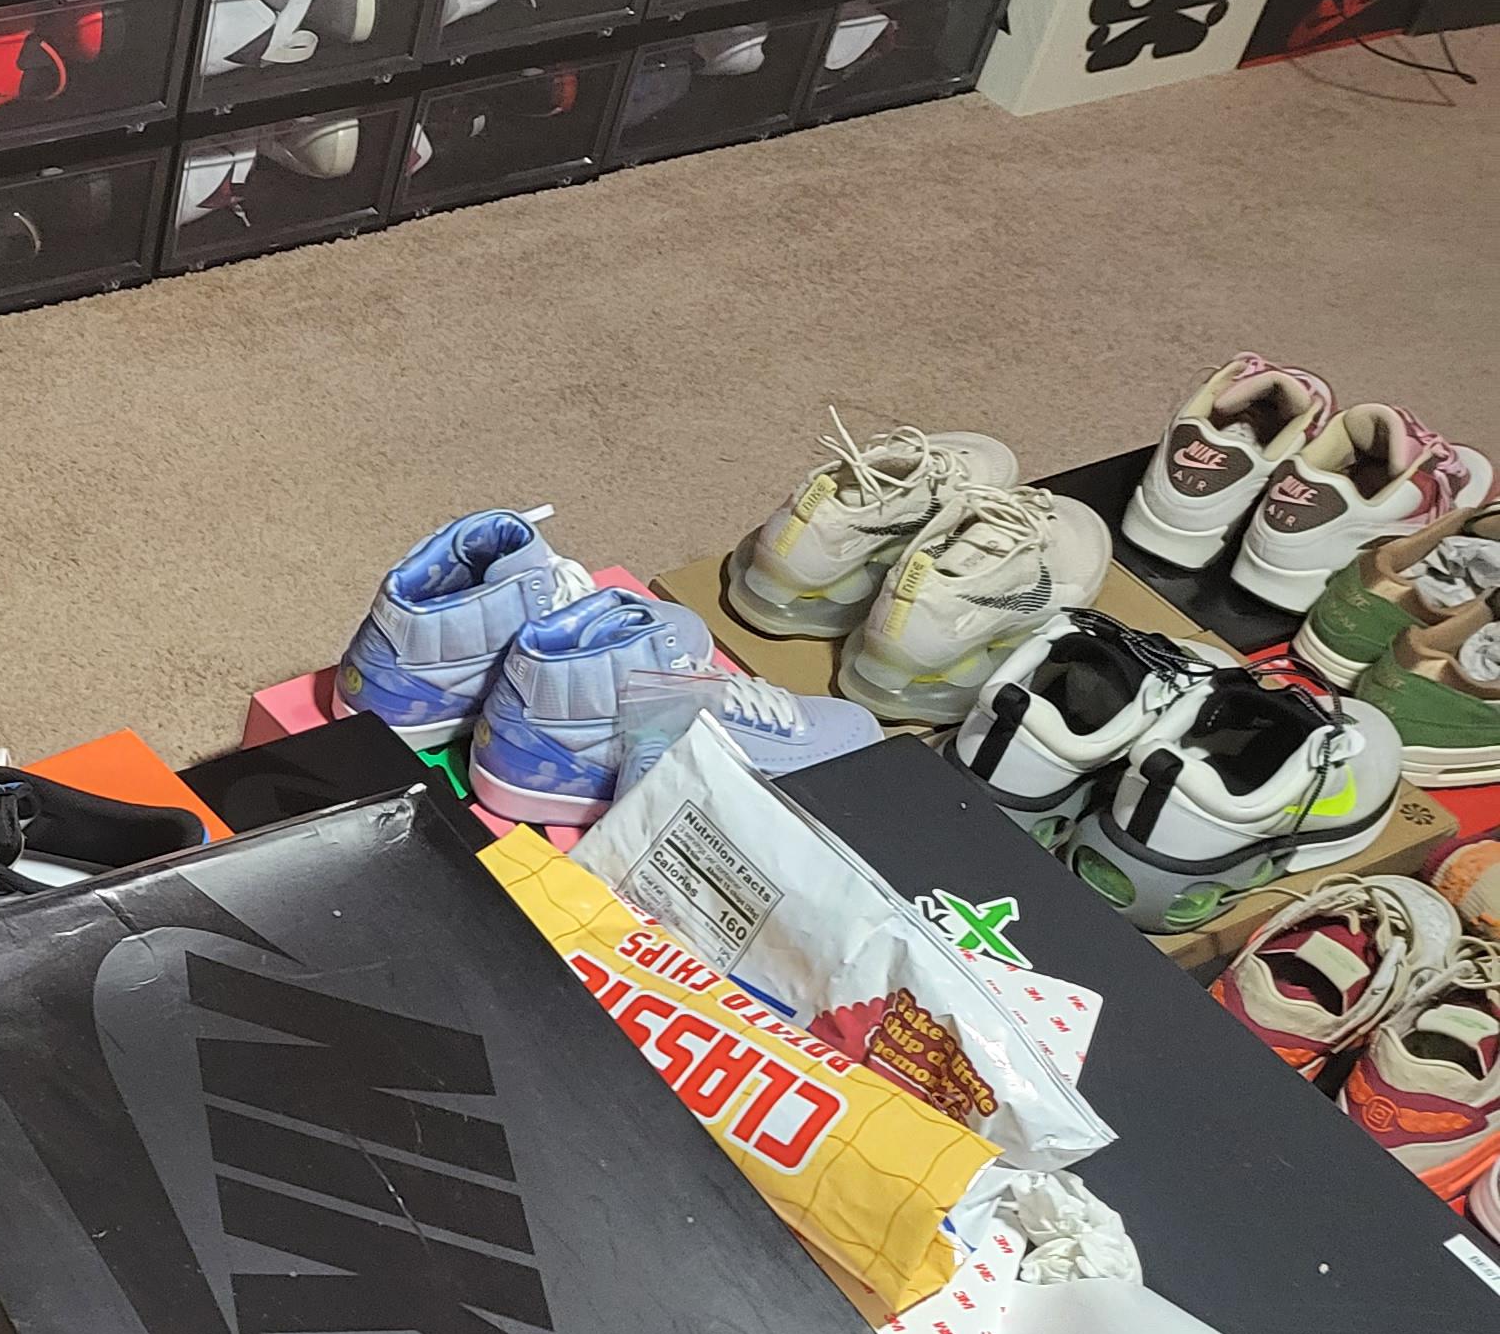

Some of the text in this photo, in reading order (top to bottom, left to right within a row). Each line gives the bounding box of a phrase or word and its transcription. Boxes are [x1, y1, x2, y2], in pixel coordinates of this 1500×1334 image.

[1186, 440, 1229, 467] NIKE
[1172, 469, 1208, 492] AIR
[1279, 475, 1319, 501] NIKE
[1265, 504, 1297, 527] AIR
[684, 811, 772, 903] Nutrition Facts
[653, 850, 747, 941] Calories 160
[618, 931, 722, 990] CHIPS
[1025, 987, 1045, 1002] 3M
[1068, 995, 1088, 1012] 3M
[721, 993, 853, 1073] POTATO
[883, 1015, 925, 1055] chip
[1050, 1016, 1071, 1033] 3M
[896, 991, 944, 1041] Take
[951, 1053, 994, 1113] little
[993, 1234, 1015, 1254] 3M
[973, 1263, 996, 1283] 3M
[953, 1290, 976, 1310] 3M
[884, 1313, 907, 1332] 3M
